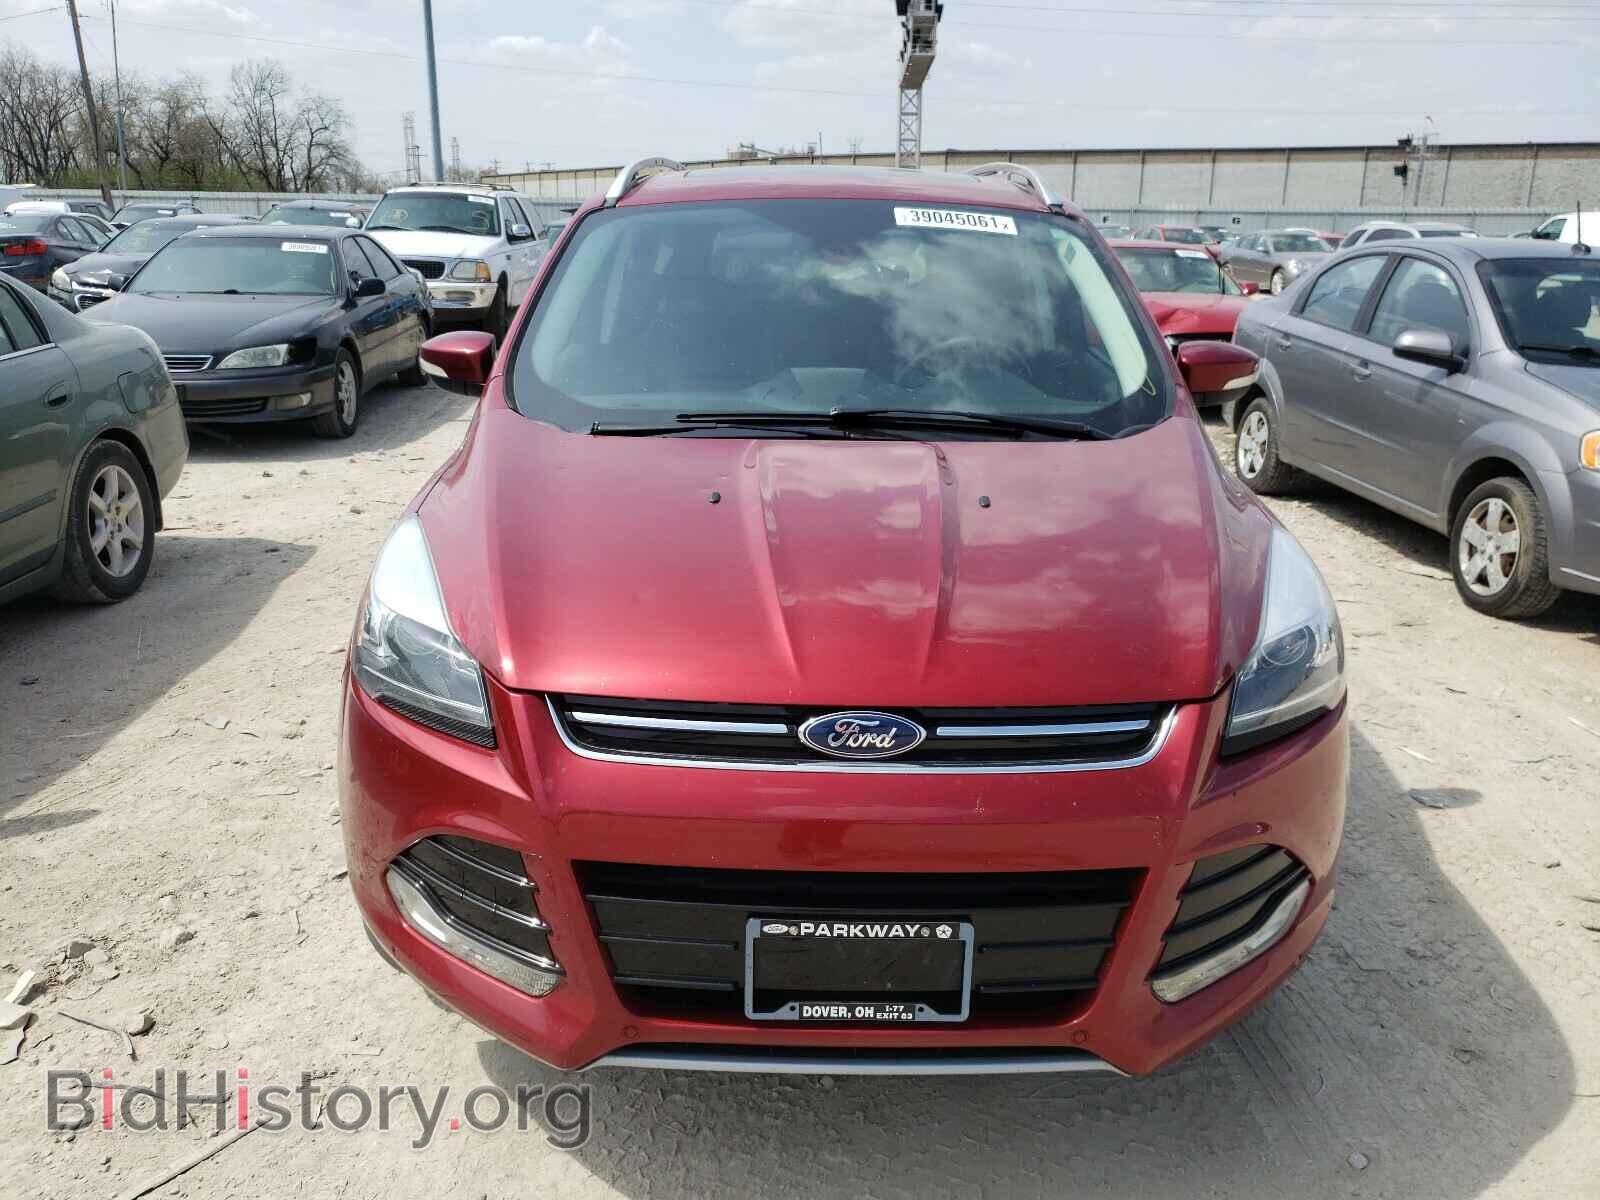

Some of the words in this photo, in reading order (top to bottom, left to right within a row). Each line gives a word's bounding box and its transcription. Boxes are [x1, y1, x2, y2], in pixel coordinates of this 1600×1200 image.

[909, 209, 998, 229] 39045061
[827, 718, 897, 748] Ford
[800, 922, 921, 938] PARKWAY
[802, 1005, 852, 1019] DOVER,
[854, 1006, 875, 1018] OH
[876, 1012, 899, 1020] EXIT
